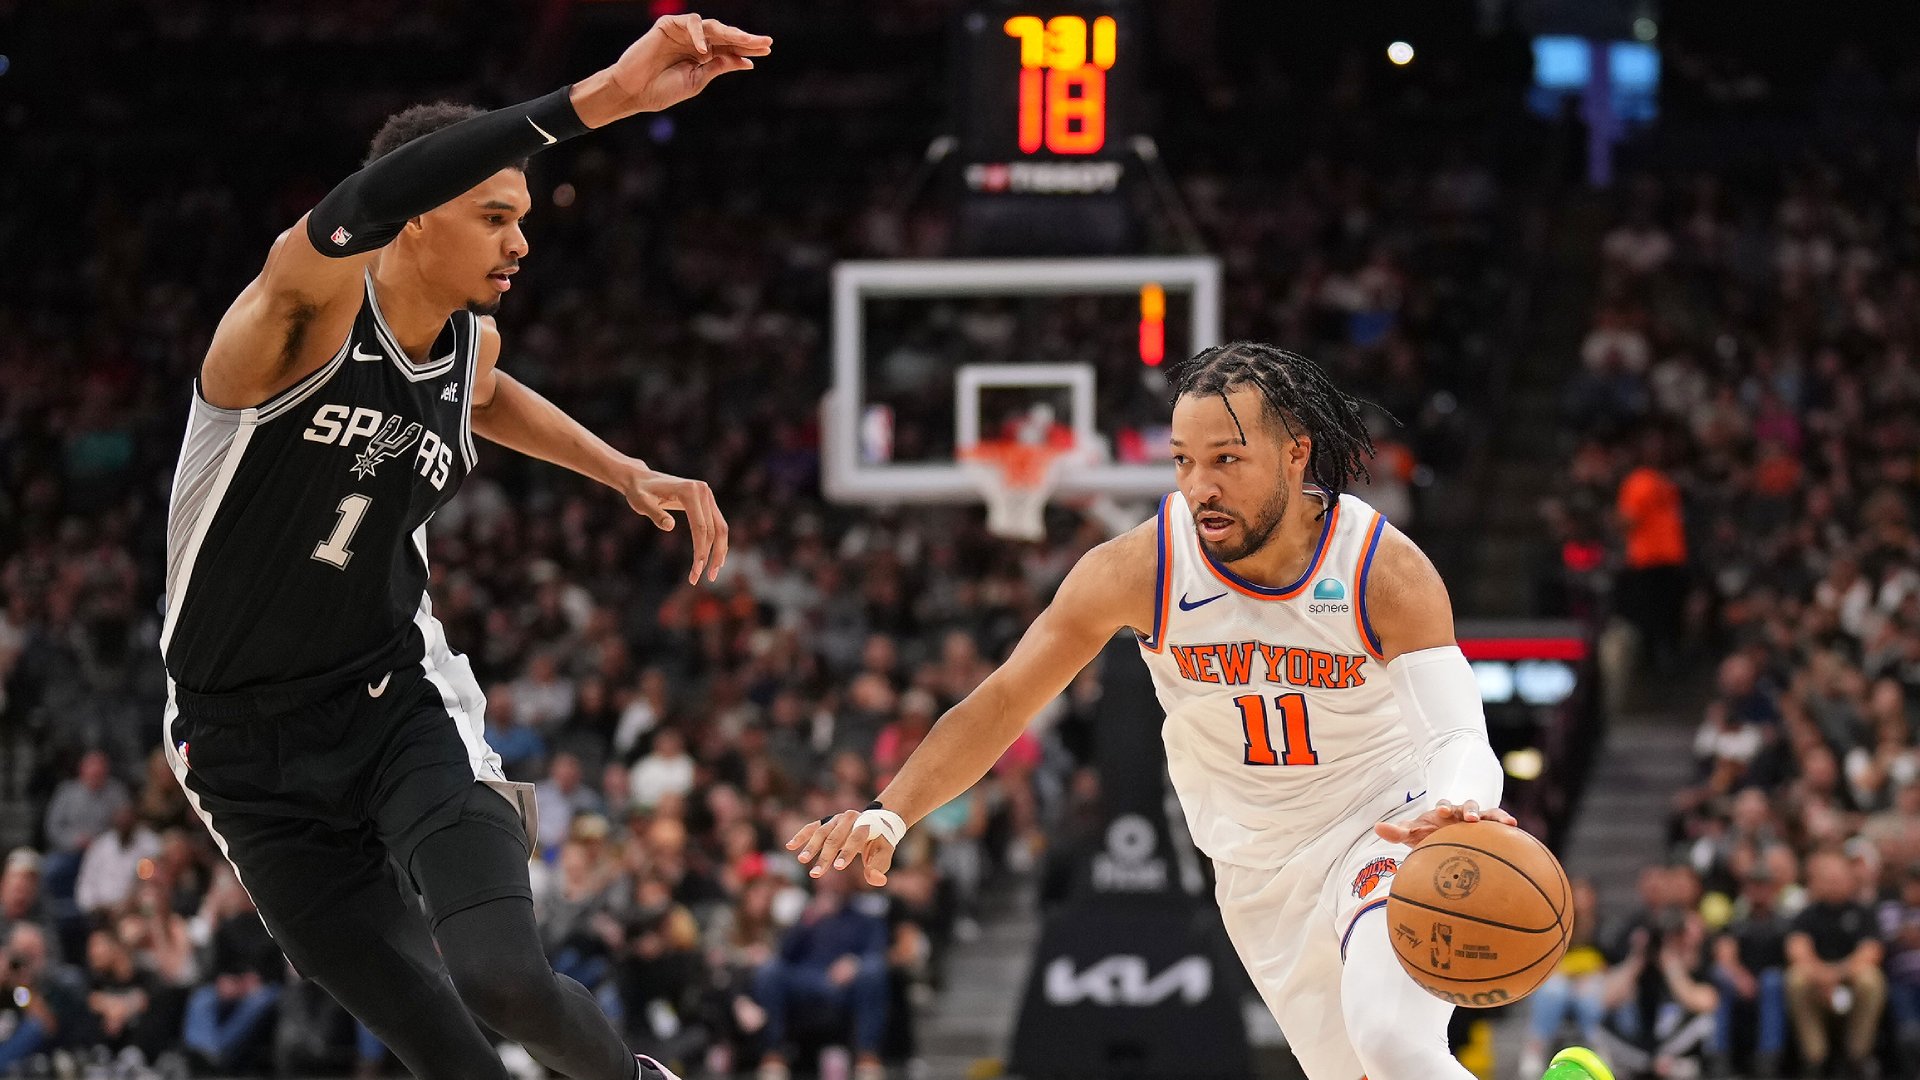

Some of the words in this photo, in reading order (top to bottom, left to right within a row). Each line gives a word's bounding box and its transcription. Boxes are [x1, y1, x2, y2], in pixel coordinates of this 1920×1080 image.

[1018, 64, 1106, 154] 18
[303, 403, 453, 491] SPURS
[310, 493, 373, 571] 1
[1308, 602, 1349, 615] sphere
[1169, 641, 1256, 686] NEW
[1257, 642, 1368, 689] YORK
[1232, 692, 1319, 766] 11
